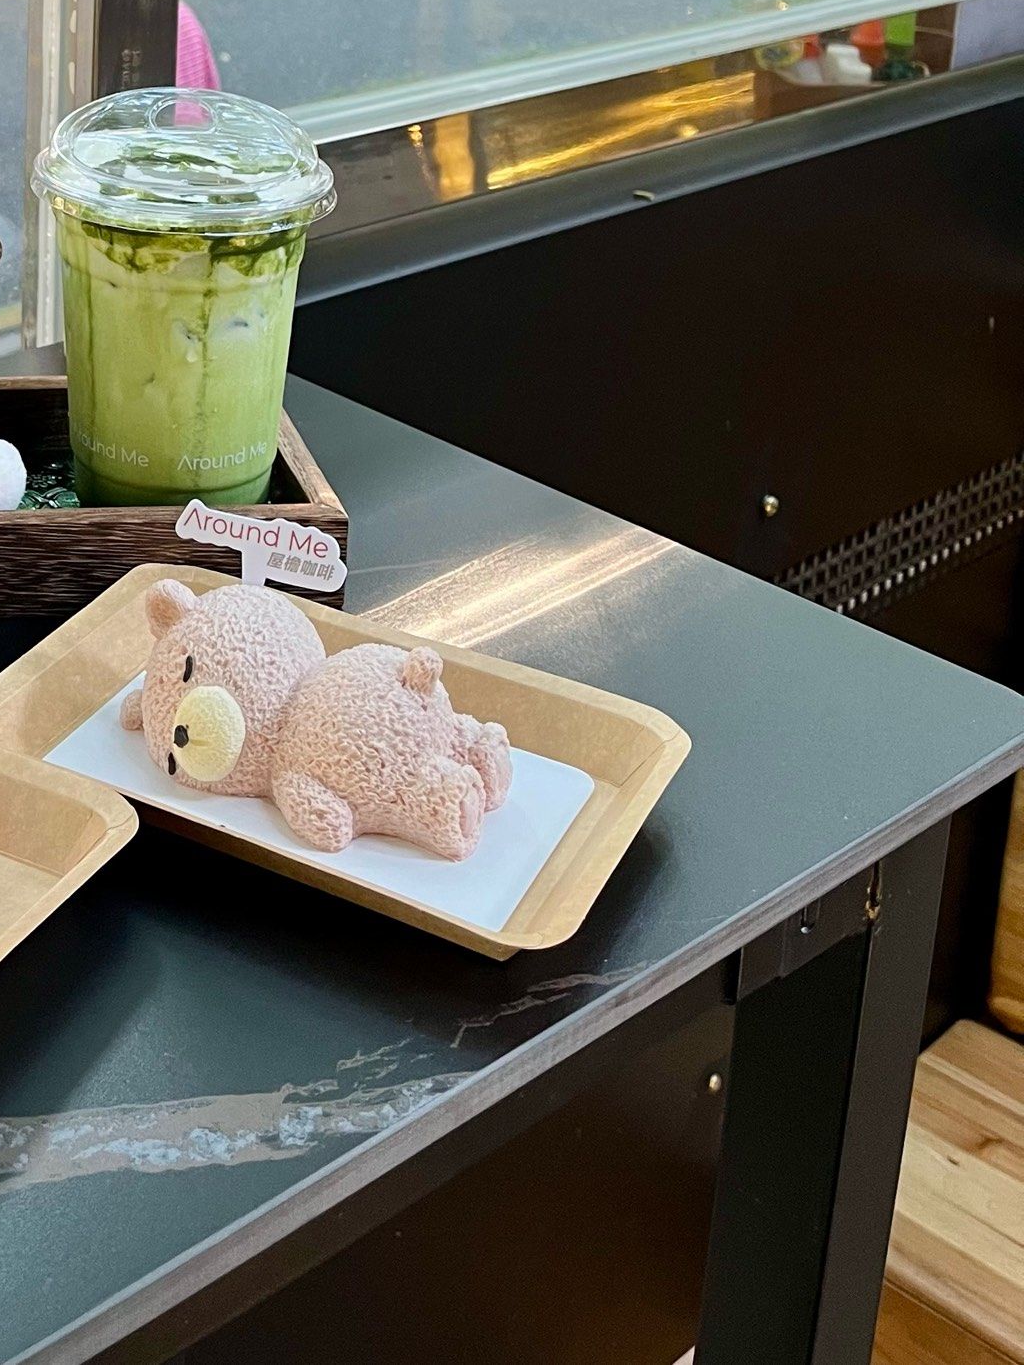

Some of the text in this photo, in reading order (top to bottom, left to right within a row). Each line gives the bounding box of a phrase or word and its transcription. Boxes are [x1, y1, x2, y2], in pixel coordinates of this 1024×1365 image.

[80, 433, 150, 467] ound Me
[177, 440, 268, 471] Around Me
[183, 507, 329, 559] Around Me
